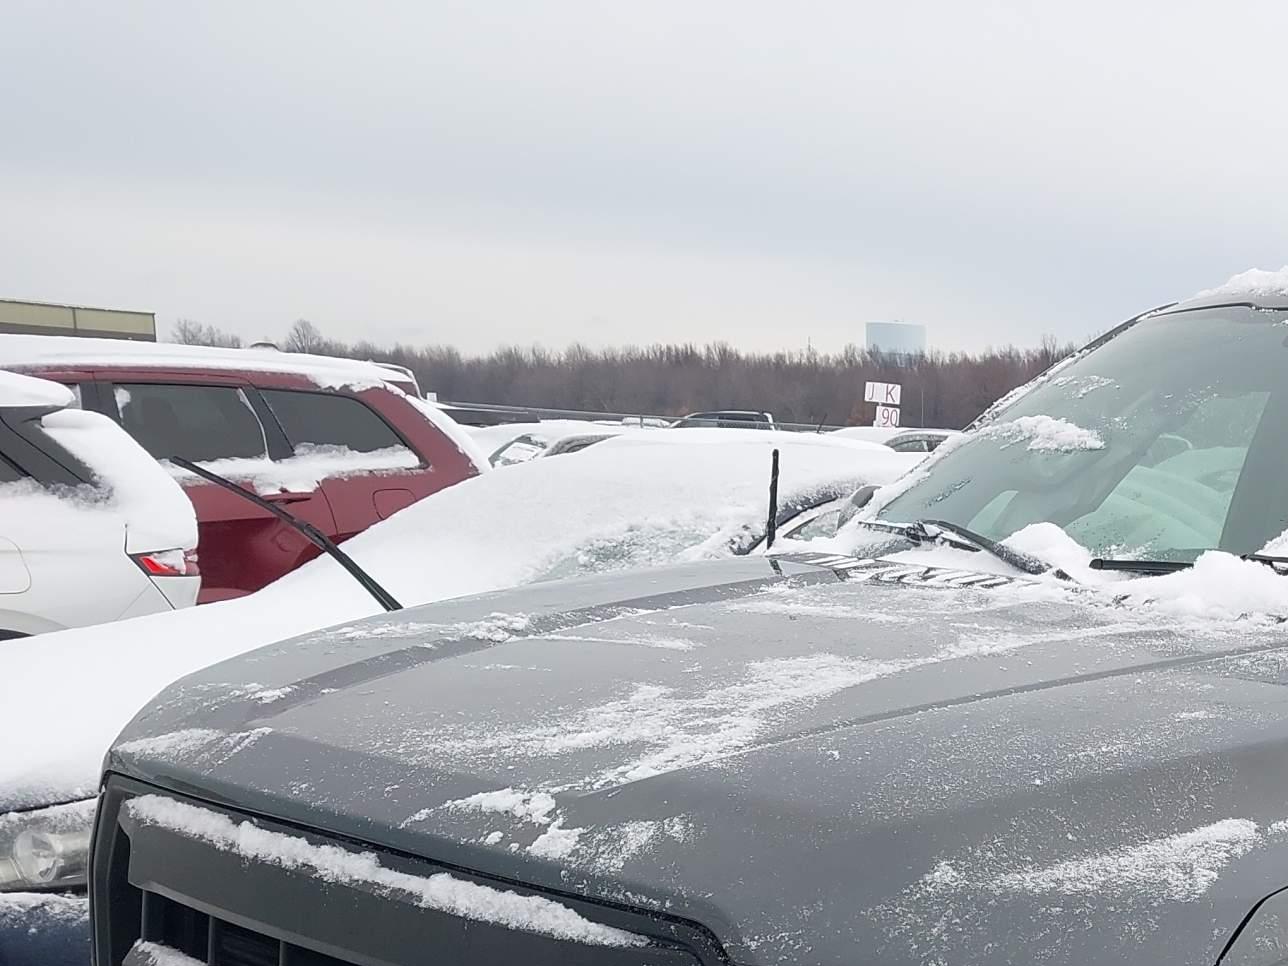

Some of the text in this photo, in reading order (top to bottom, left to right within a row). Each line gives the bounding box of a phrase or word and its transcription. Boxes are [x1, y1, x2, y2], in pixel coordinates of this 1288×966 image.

[868, 383, 896, 403] J K
[881, 408, 899, 426] 90
